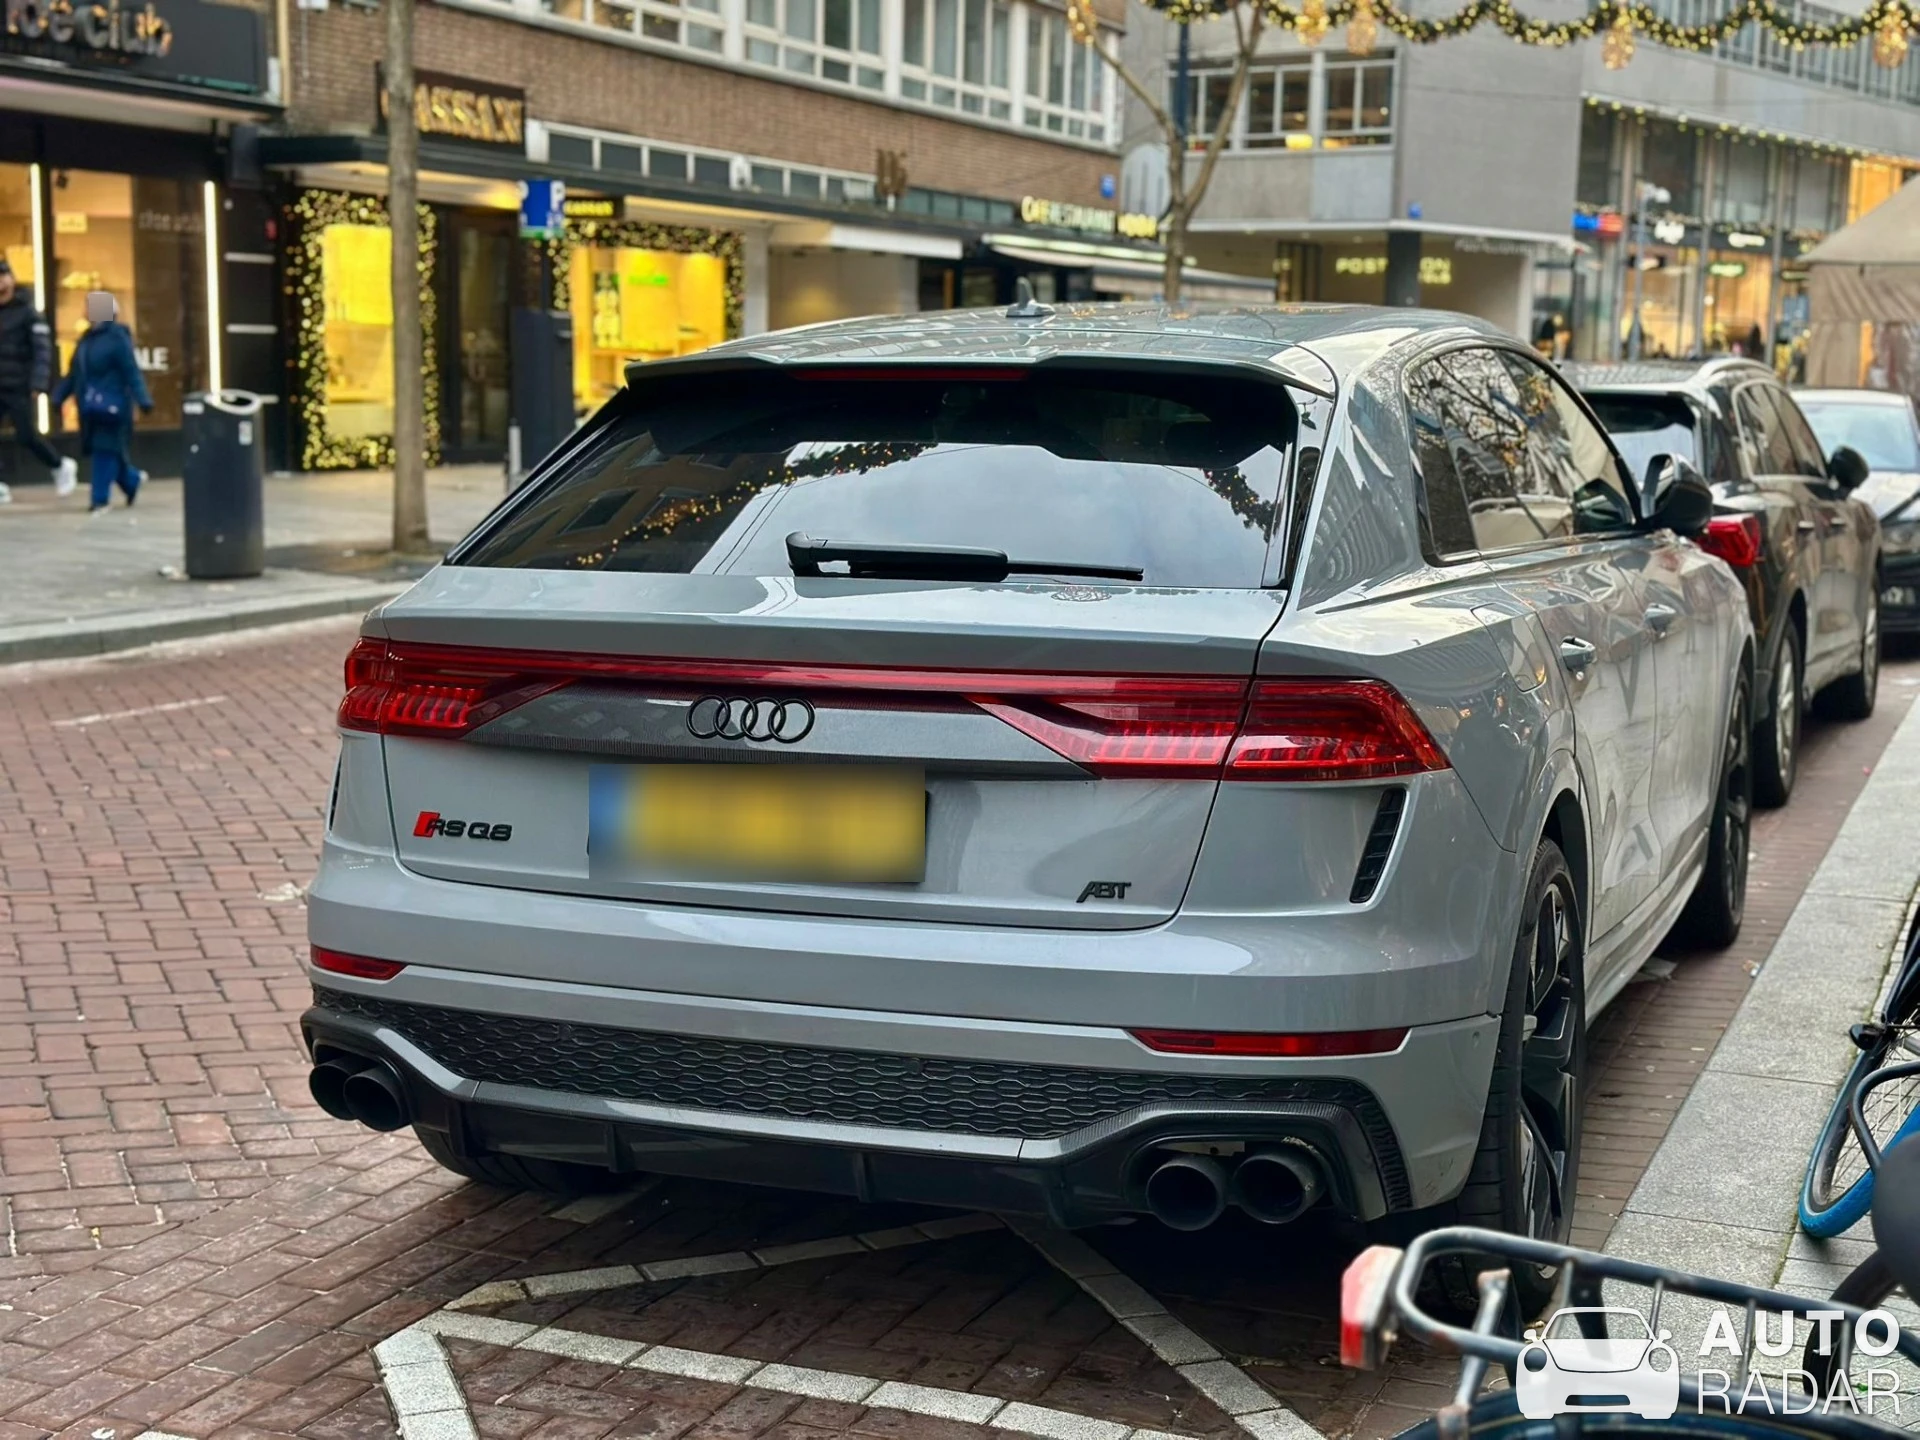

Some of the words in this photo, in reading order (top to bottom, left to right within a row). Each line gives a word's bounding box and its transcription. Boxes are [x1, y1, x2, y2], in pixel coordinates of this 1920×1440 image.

[381, 84, 522, 144] ASSAN
[1336, 257, 1388, 274] POST
[1076, 881, 1132, 903] ABT
